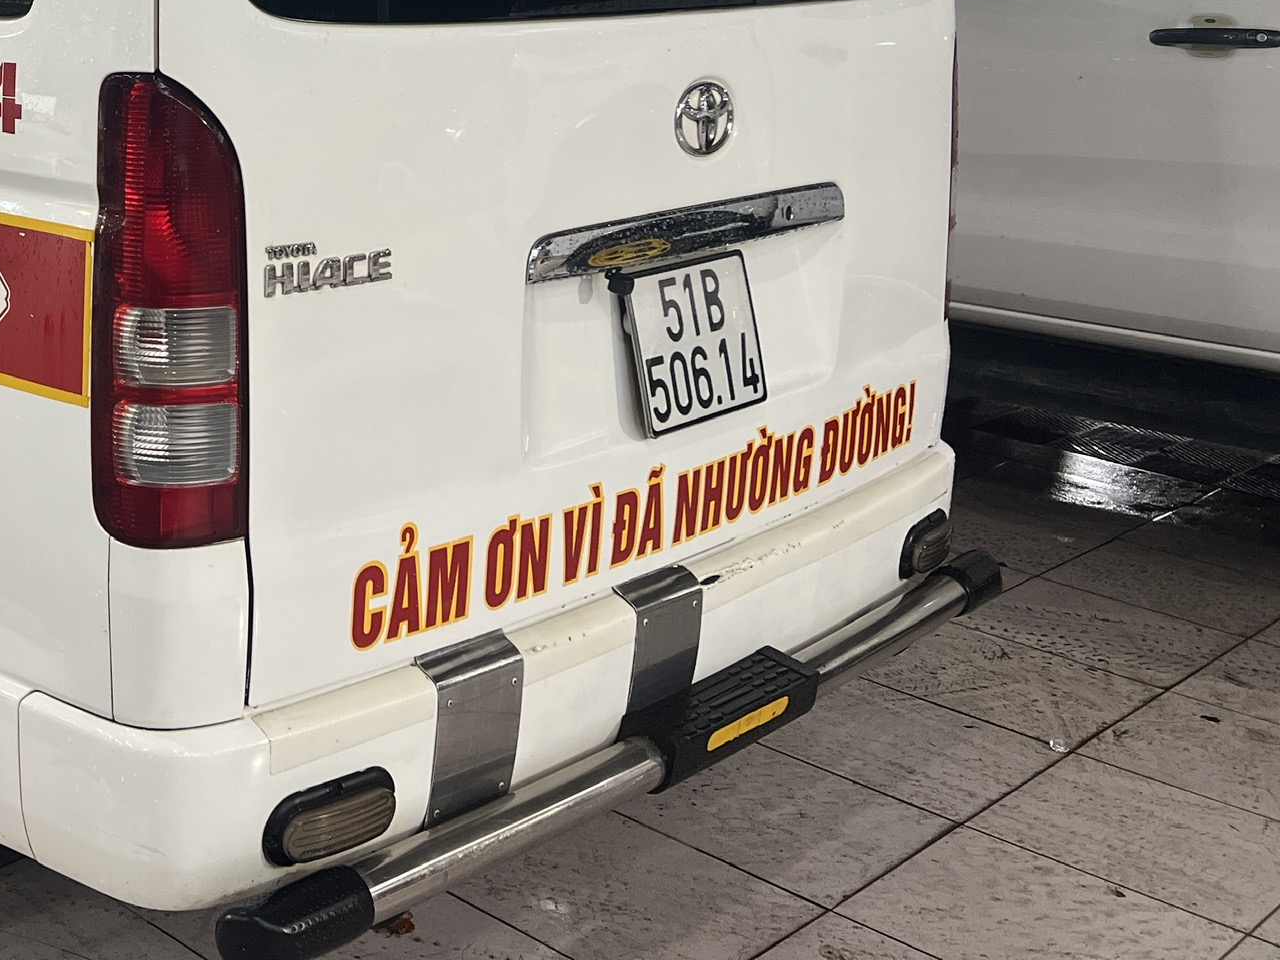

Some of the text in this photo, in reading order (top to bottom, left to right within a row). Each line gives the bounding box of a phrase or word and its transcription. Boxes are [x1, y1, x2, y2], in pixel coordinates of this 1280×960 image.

[263, 248, 393, 298] HIACE
[657, 268, 725, 342] 51B
[645, 332, 760, 423] 506.14
[349, 379, 917, 652] CẢM ƠN VÌ ĐÃ NHƯỜNG ĐƯỜNG!
